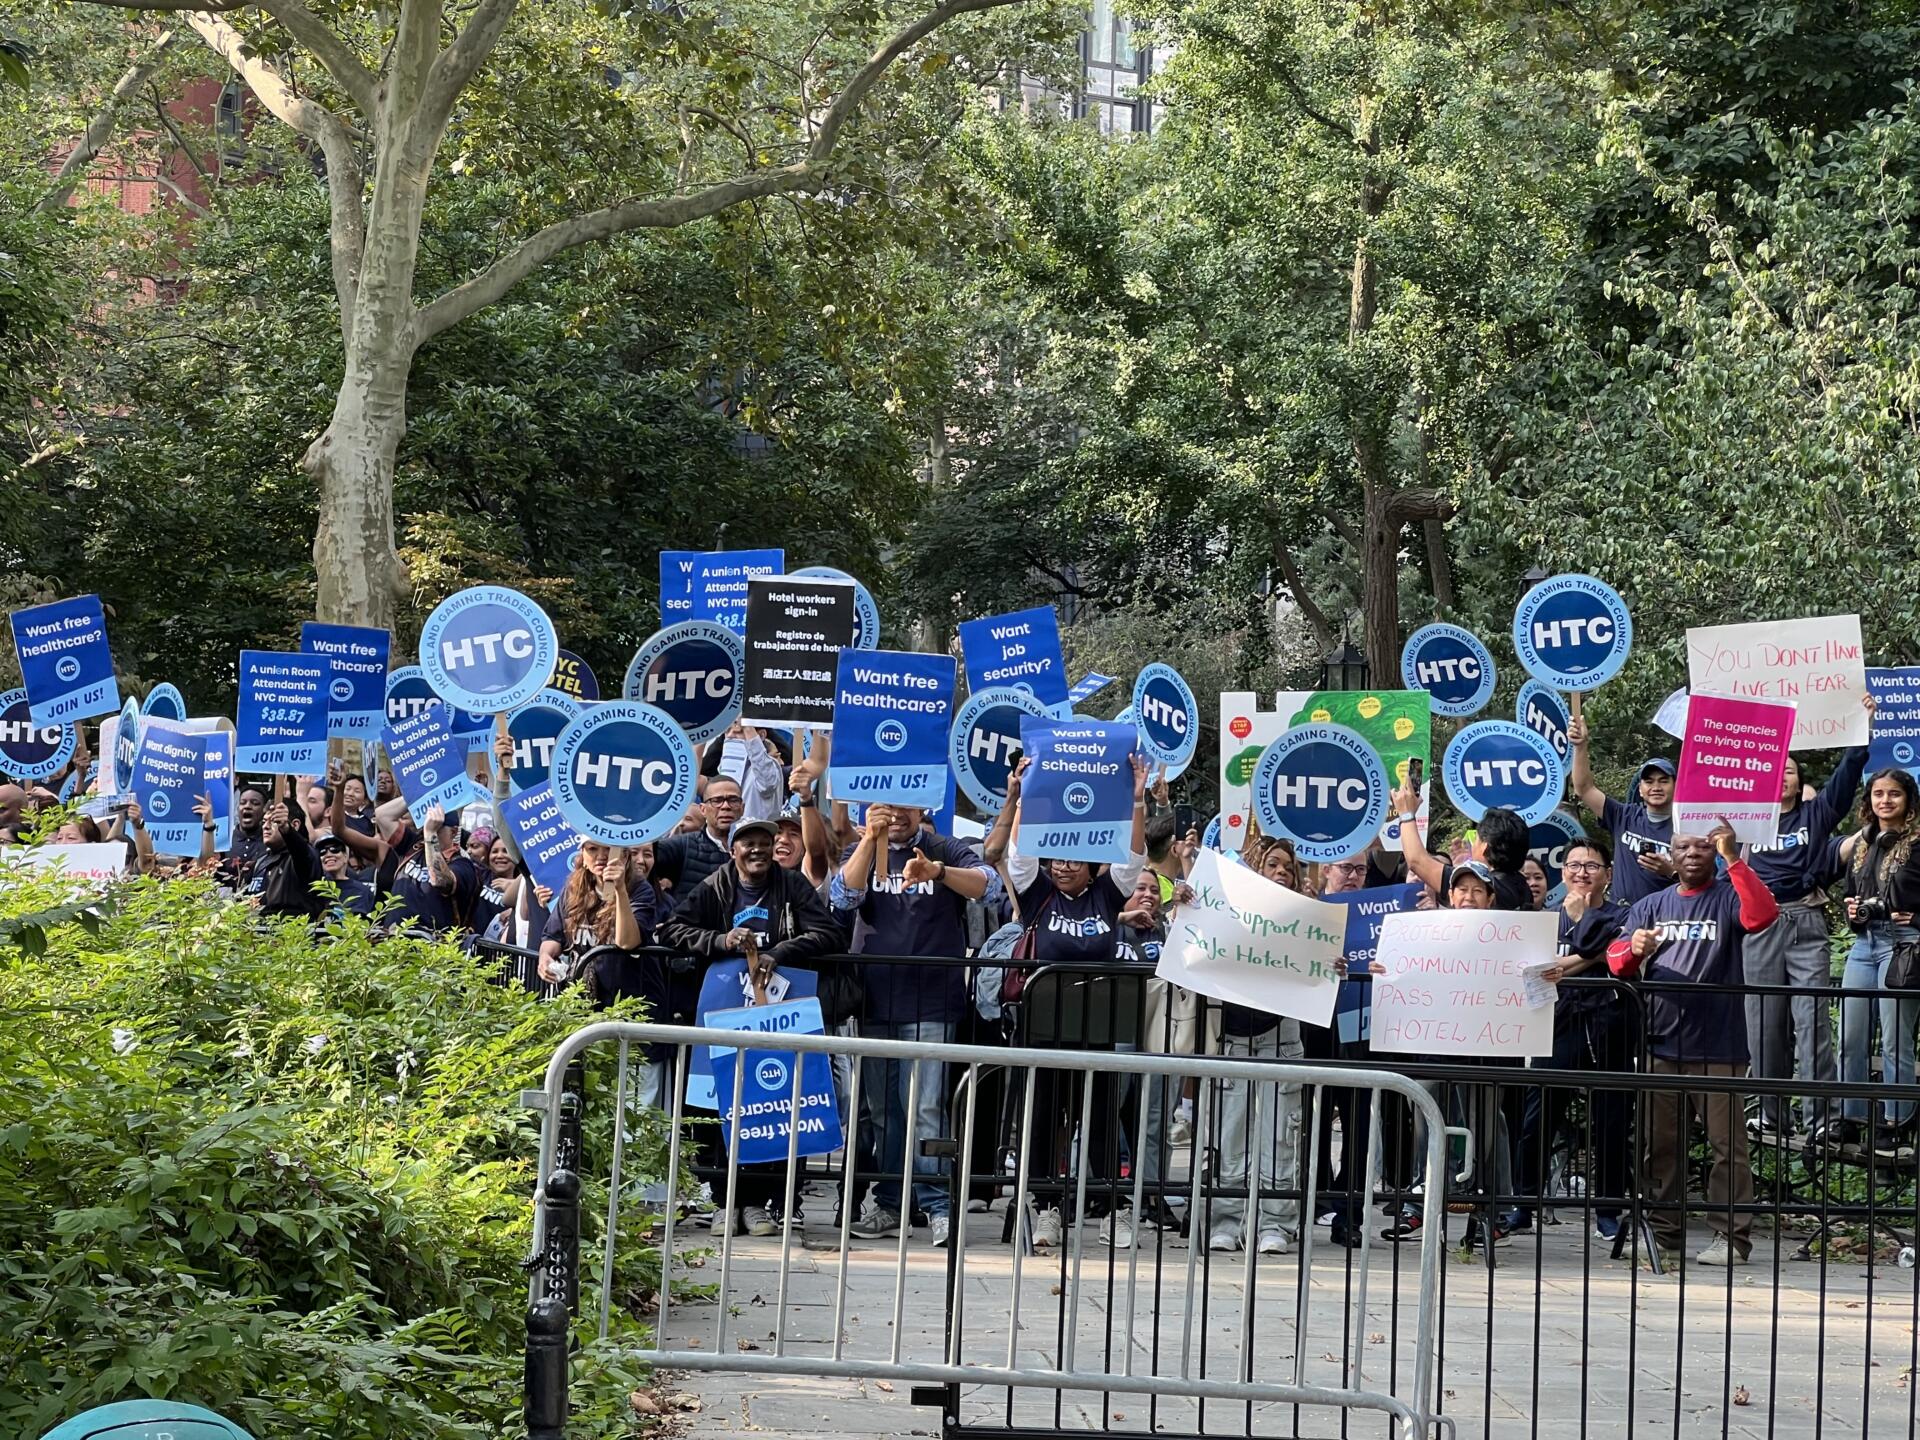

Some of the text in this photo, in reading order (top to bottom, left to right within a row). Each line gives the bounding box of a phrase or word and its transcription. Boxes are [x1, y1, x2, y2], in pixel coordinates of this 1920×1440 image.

[702, 568, 710, 577] A
[712, 566, 741, 577] union
[743, 565, 772, 575] Room
[707, 598, 729, 608] NYC
[769, 593, 836, 605] Hotel workers
[784, 606, 818, 617] sign-in
[26, 615, 91, 638] Want free
[991, 623, 1030, 639] Want
[1521, 580, 1626, 666] HOTEL AND GAMING TRADES COUNCIL
[1533, 616, 1613, 649] HTC
[22, 630, 102, 657] healthcare?
[427, 592, 548, 690] HOTEL AND GAMING TRADES COUNCIL
[754, 639, 822, 651] trabajadores de
[776, 630, 825, 641] Registro de
[313, 640, 377, 656] Want free
[443, 630, 533, 670] HTC
[636, 627, 742, 679] AND GAMING TRADES
[1002, 644, 1026, 660] job
[1408, 628, 1490, 687] AND GAMING TRADES COUNCIL
[1691, 641, 1750, 677] YOU
[1826, 640, 1860, 664] HAVE
[250, 665, 320, 677] A union Room
[854, 669, 938, 690] Want free
[983, 659, 1051, 681] security?
[1417, 657, 1480, 684] HTC
[1556, 673, 1600, 687] AFL-CIO
[253, 679, 316, 691] Attendant in
[646, 669, 732, 702] HTC
[1777, 679, 1798, 697] IN
[1806, 673, 1850, 693] FEAR
[1871, 676, 1920, 687] Want to
[48, 688, 104, 718] JOIN US!
[255, 693, 313, 704] NYC makes
[472, 691, 522, 708] AFL-CIO
[841, 691, 946, 714] healthcare?
[1443, 702, 1475, 713] AFL-CIO
[1885, 692, 1913, 703] able
[261, 706, 305, 724] $38.87
[349, 717, 370, 727] US!
[392, 712, 431, 735] Want to
[1143, 695, 1187, 734] HTC
[0, 721, 61, 744] HTC
[260, 727, 304, 736] per hour
[390, 722, 440, 750] be able to
[881, 731, 901, 741] HTC
[955, 693, 1020, 772] HOTEL AND GAMING
[1052, 730, 1106, 738] Want a
[1527, 702, 1567, 754] HTC
[1703, 718, 1777, 737] The agencies
[146, 739, 198, 761] Want dignity
[391, 734, 450, 766] retire with a
[1054, 742, 1107, 756] steady
[1278, 729, 1328, 752] GAMING
[1332, 732, 1373, 768] TRADES
[1694, 734, 1780, 753] are lying to you.
[147, 758, 178, 772] respect
[181, 765, 195, 775] on
[252, 748, 312, 764] JOIN US!
[402, 748, 446, 776] pension?
[558, 708, 689, 812] HOTEL AND GAMING TRADES COUNCIL
[1264, 753, 1279, 779] AND
[1449, 725, 1558, 803] HOTEL AND GAMING TRADES COUNCIL
[1696, 751, 1773, 772] Learn the
[575, 752, 673, 795] HTC
[1041, 759, 1119, 775] schedule?
[1464, 760, 1545, 787] HTC
[145, 772, 183, 788] the job?
[849, 773, 928, 790] JOIN US!
[1708, 775, 1755, 791] truth!
[444, 782, 463, 800] US!
[518, 790, 554, 812] Want
[1069, 795, 1088, 804] HTC
[1277, 776, 1367, 810] HTC
[1364, 770, 1381, 827] COUNCIL
[1259, 783, 1276, 826] HOTEL
[520, 817, 538, 831] be
[590, 825, 644, 840] AFL-CIO
[166, 829, 188, 841] US!
[522, 829, 554, 851] retire
[1037, 831, 1114, 848] JOIN US!
[1295, 844, 1347, 857] AFL-CIO
[1358, 900, 1400, 916] Want
[1048, 914, 1111, 937] UNION
[1304, 925, 1341, 945] the
[1383, 918, 1523, 943] PROTECT OUR
[1185, 924, 1226, 960] Safe
[1237, 944, 1302, 973] Hotels
[1377, 985, 1433, 1009] PASS
[1452, 990, 1485, 1006] THE
[1384, 1017, 1526, 1045] HOTEL ACT
[740, 1123, 775, 1139] free
